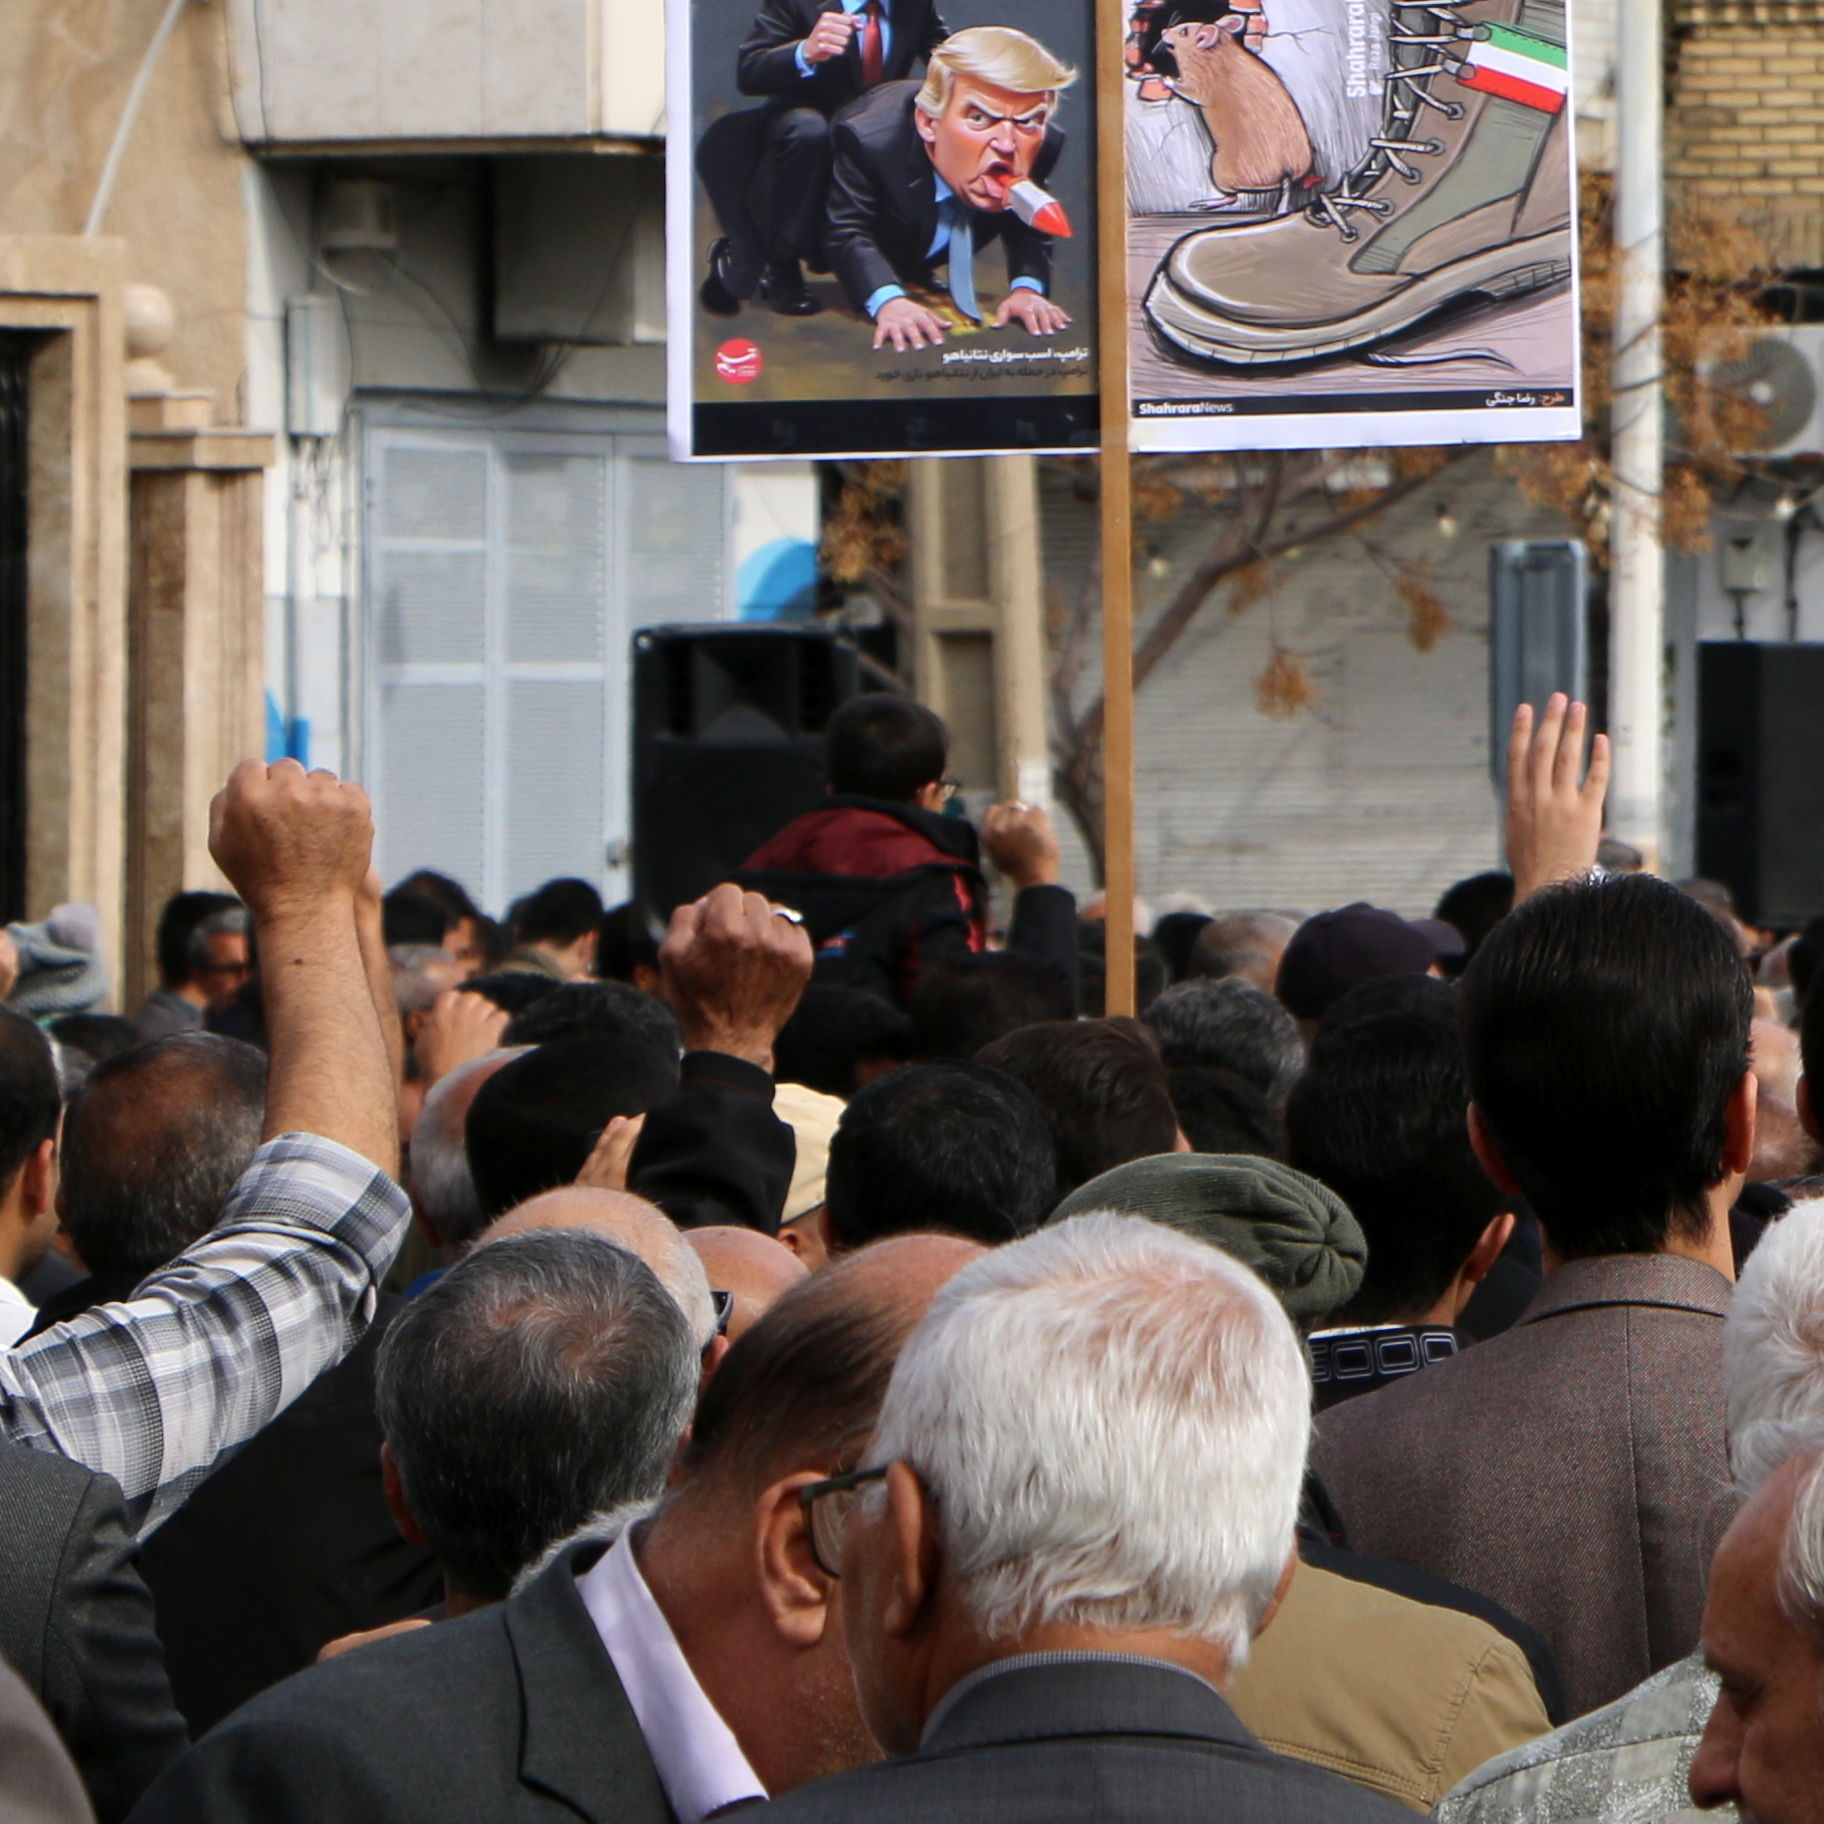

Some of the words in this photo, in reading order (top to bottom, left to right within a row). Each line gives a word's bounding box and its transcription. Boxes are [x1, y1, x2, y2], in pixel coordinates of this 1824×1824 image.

[942, 348, 989, 365] نتانیاهو
[988, 348, 1024, 364] سواری
[1138, 401, 1233, 416] ShahraraNews
